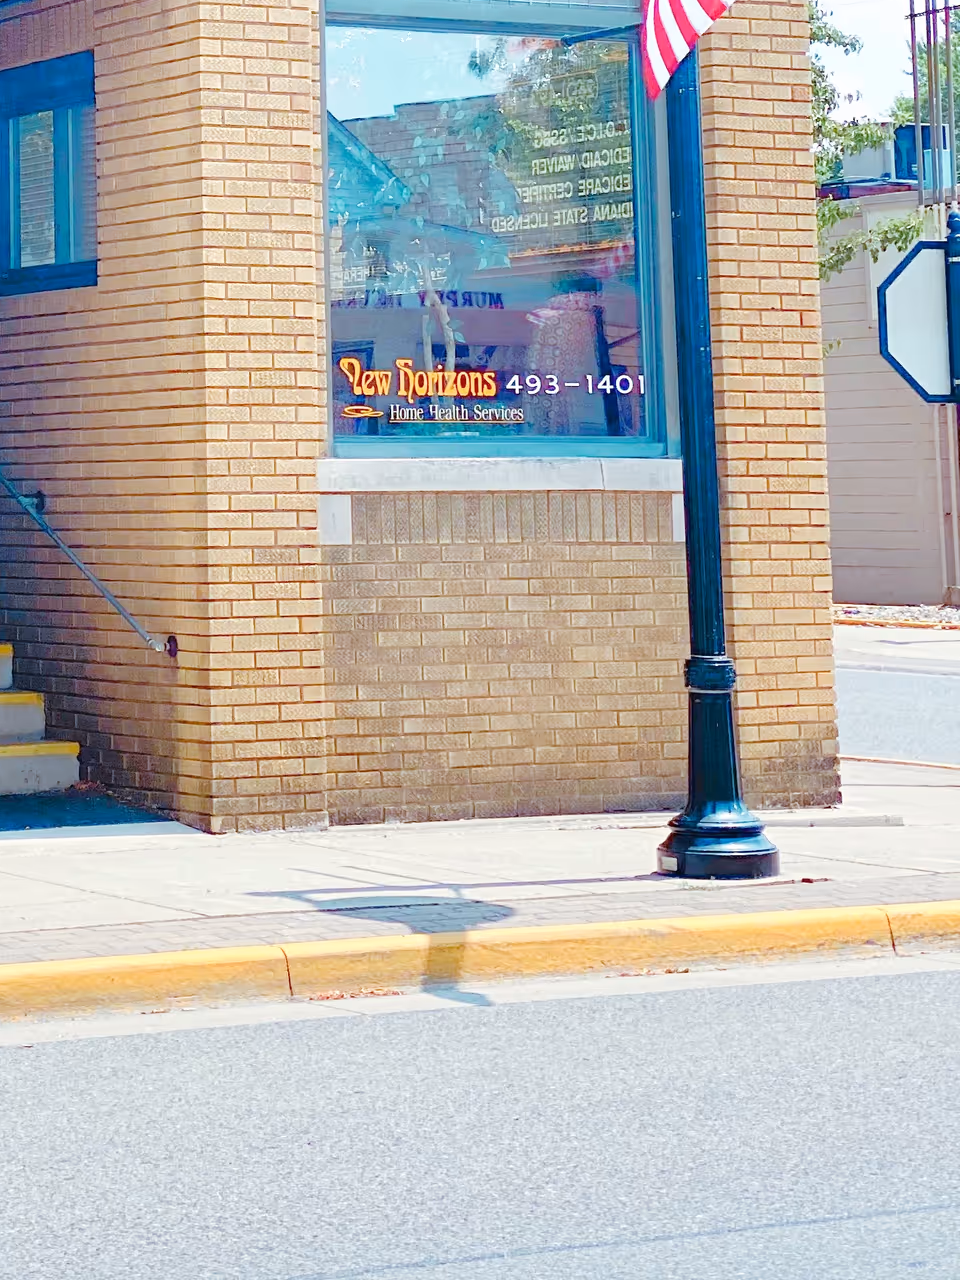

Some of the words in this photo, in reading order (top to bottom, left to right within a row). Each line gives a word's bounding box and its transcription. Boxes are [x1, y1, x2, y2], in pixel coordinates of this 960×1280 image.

[339, 357, 391, 397] New
[395, 358, 496, 404] Horizons
[506, 373, 645, 395] 493-1401
[389, 404, 424, 421] Home
[429, 404, 469, 421] Health
[473, 404, 525, 422] Services
